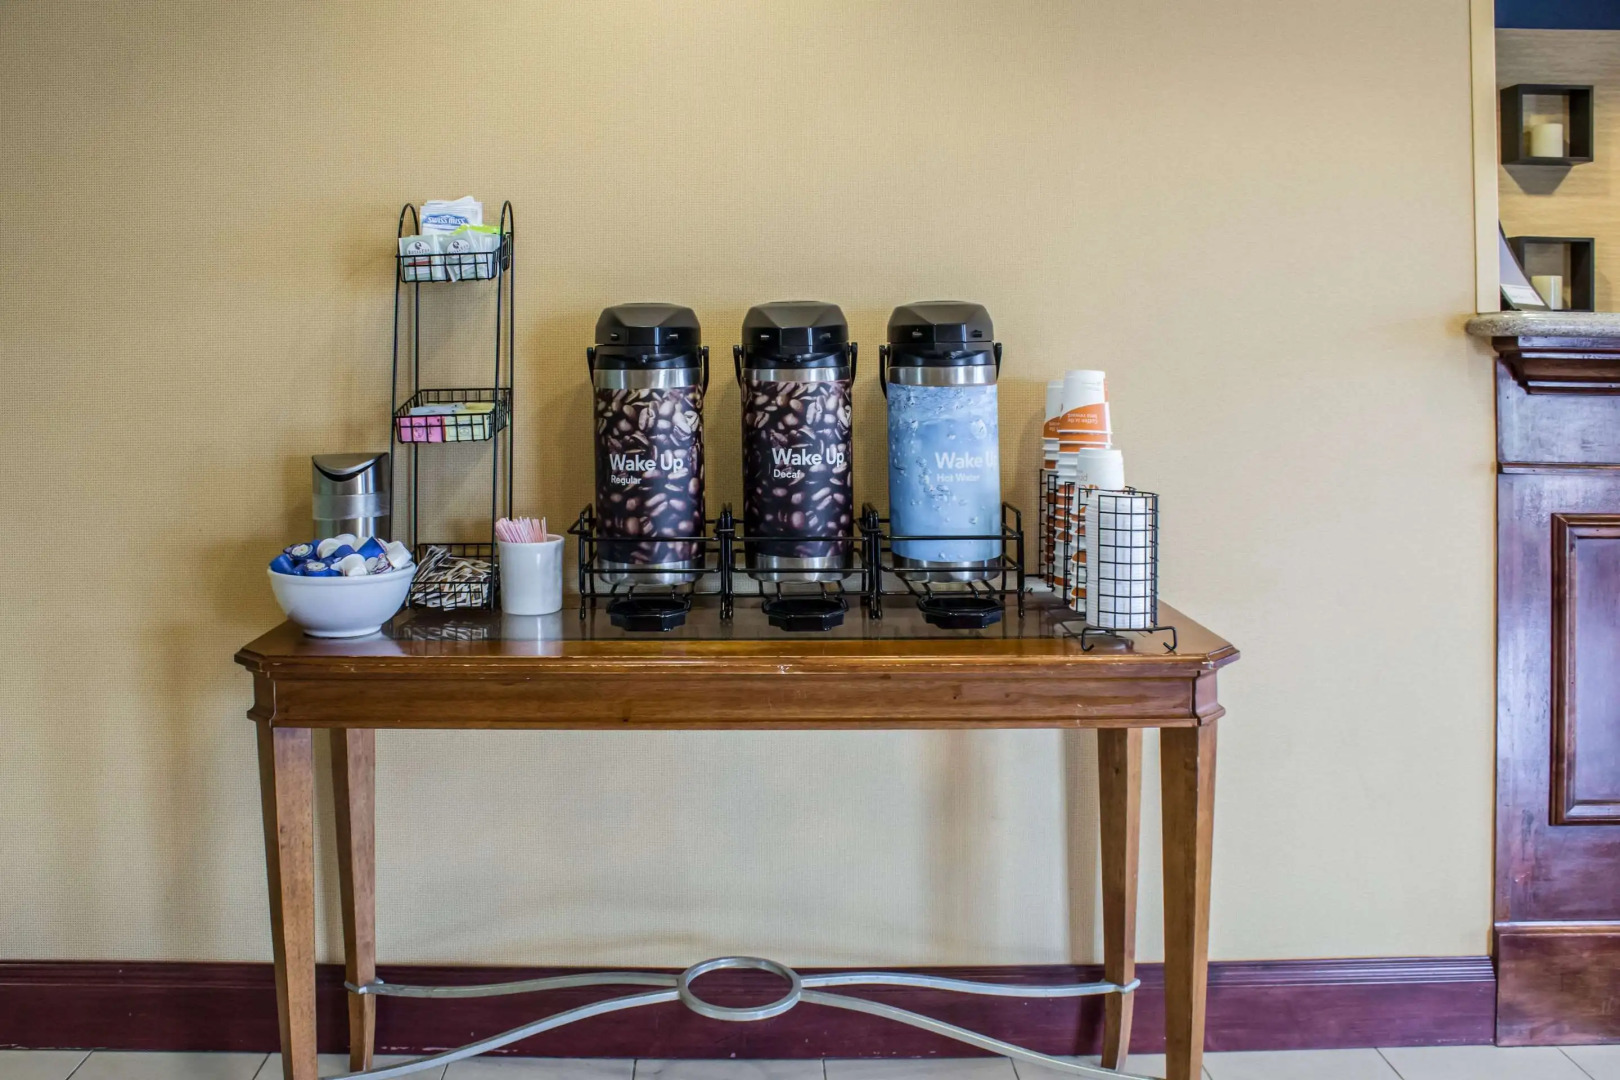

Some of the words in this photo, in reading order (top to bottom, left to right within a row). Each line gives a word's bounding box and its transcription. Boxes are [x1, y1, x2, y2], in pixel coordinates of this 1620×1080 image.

[609, 453, 656, 471] Wake
[660, 453, 683, 473] Up
[772, 447, 822, 466] Wake
[826, 447, 844, 468] Up
[934, 451, 983, 469] Wake
[610, 475, 642, 486] Regular
[773, 469, 801, 479] Decaf
